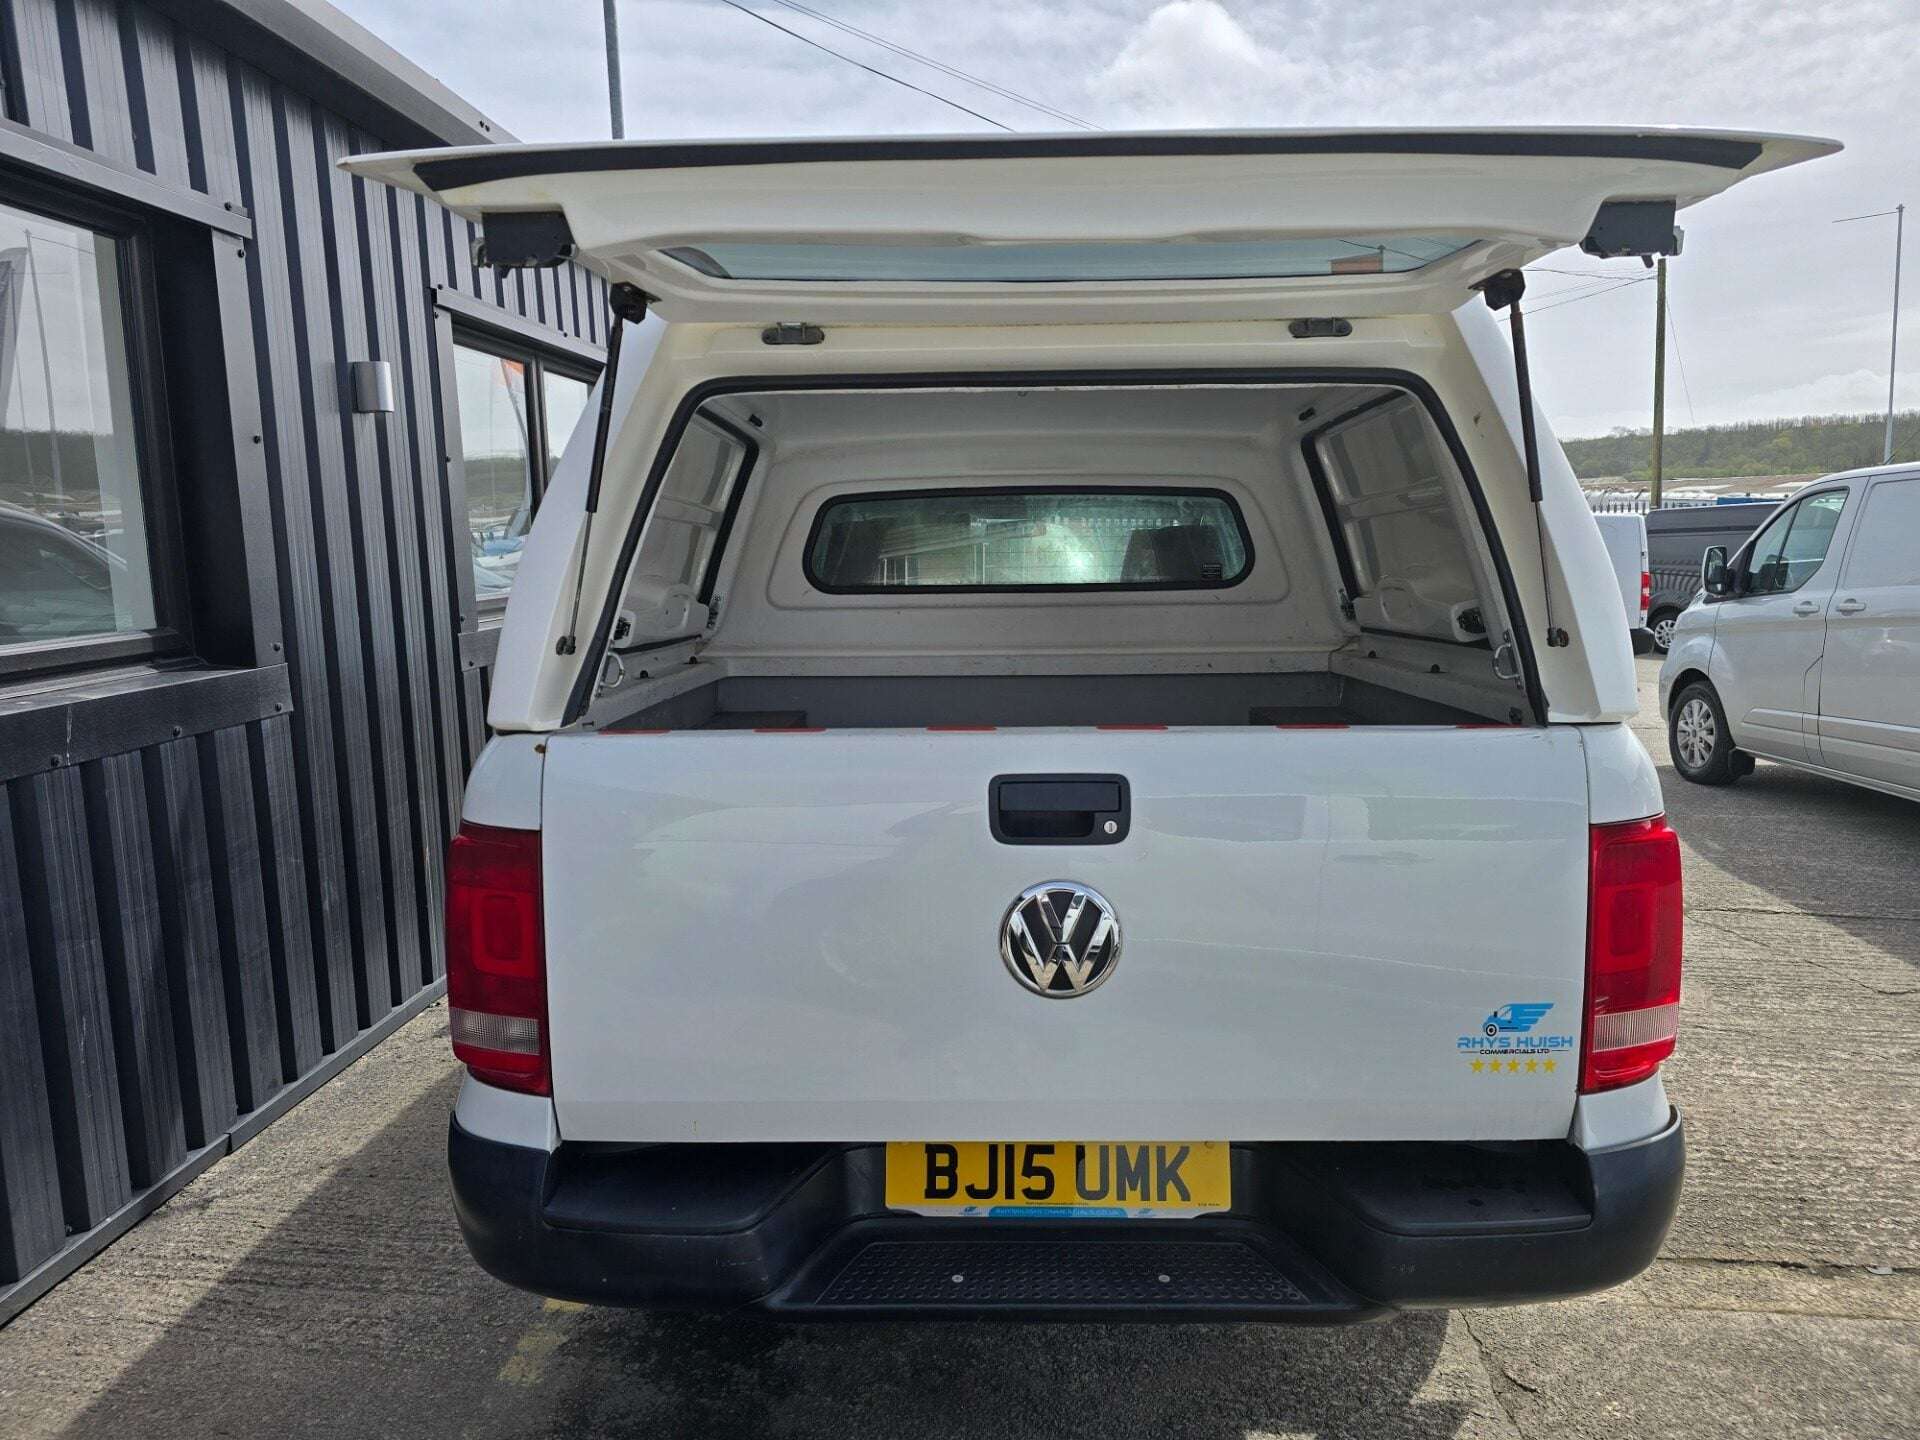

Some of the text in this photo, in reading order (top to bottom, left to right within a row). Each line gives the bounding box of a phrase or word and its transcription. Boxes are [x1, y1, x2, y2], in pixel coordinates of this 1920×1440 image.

[1457, 1035, 1573, 1049] RHYS HUISH
[924, 1143, 1191, 1202] BJ15 UMK
